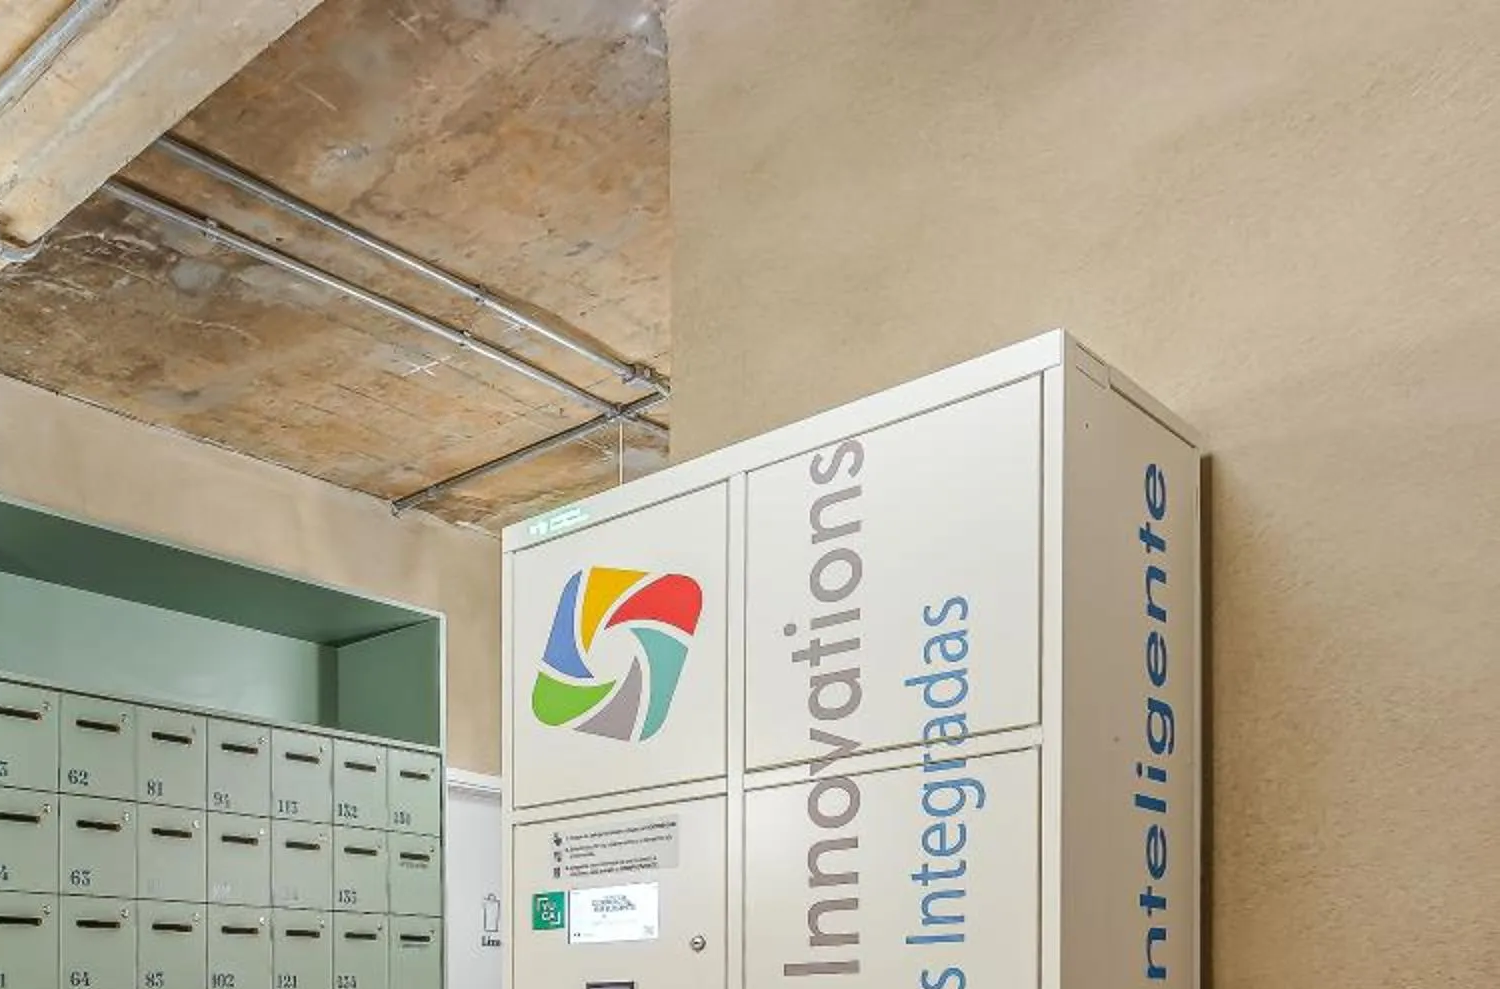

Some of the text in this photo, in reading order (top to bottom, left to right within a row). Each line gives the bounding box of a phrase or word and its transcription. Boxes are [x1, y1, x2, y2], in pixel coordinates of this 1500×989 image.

[783, 439, 865, 977] Innovations
[67, 768, 89, 786] 62
[904, 595, 986, 945] Integradas
[147, 780, 164, 797] 81
[69, 971, 91, 987] 64
